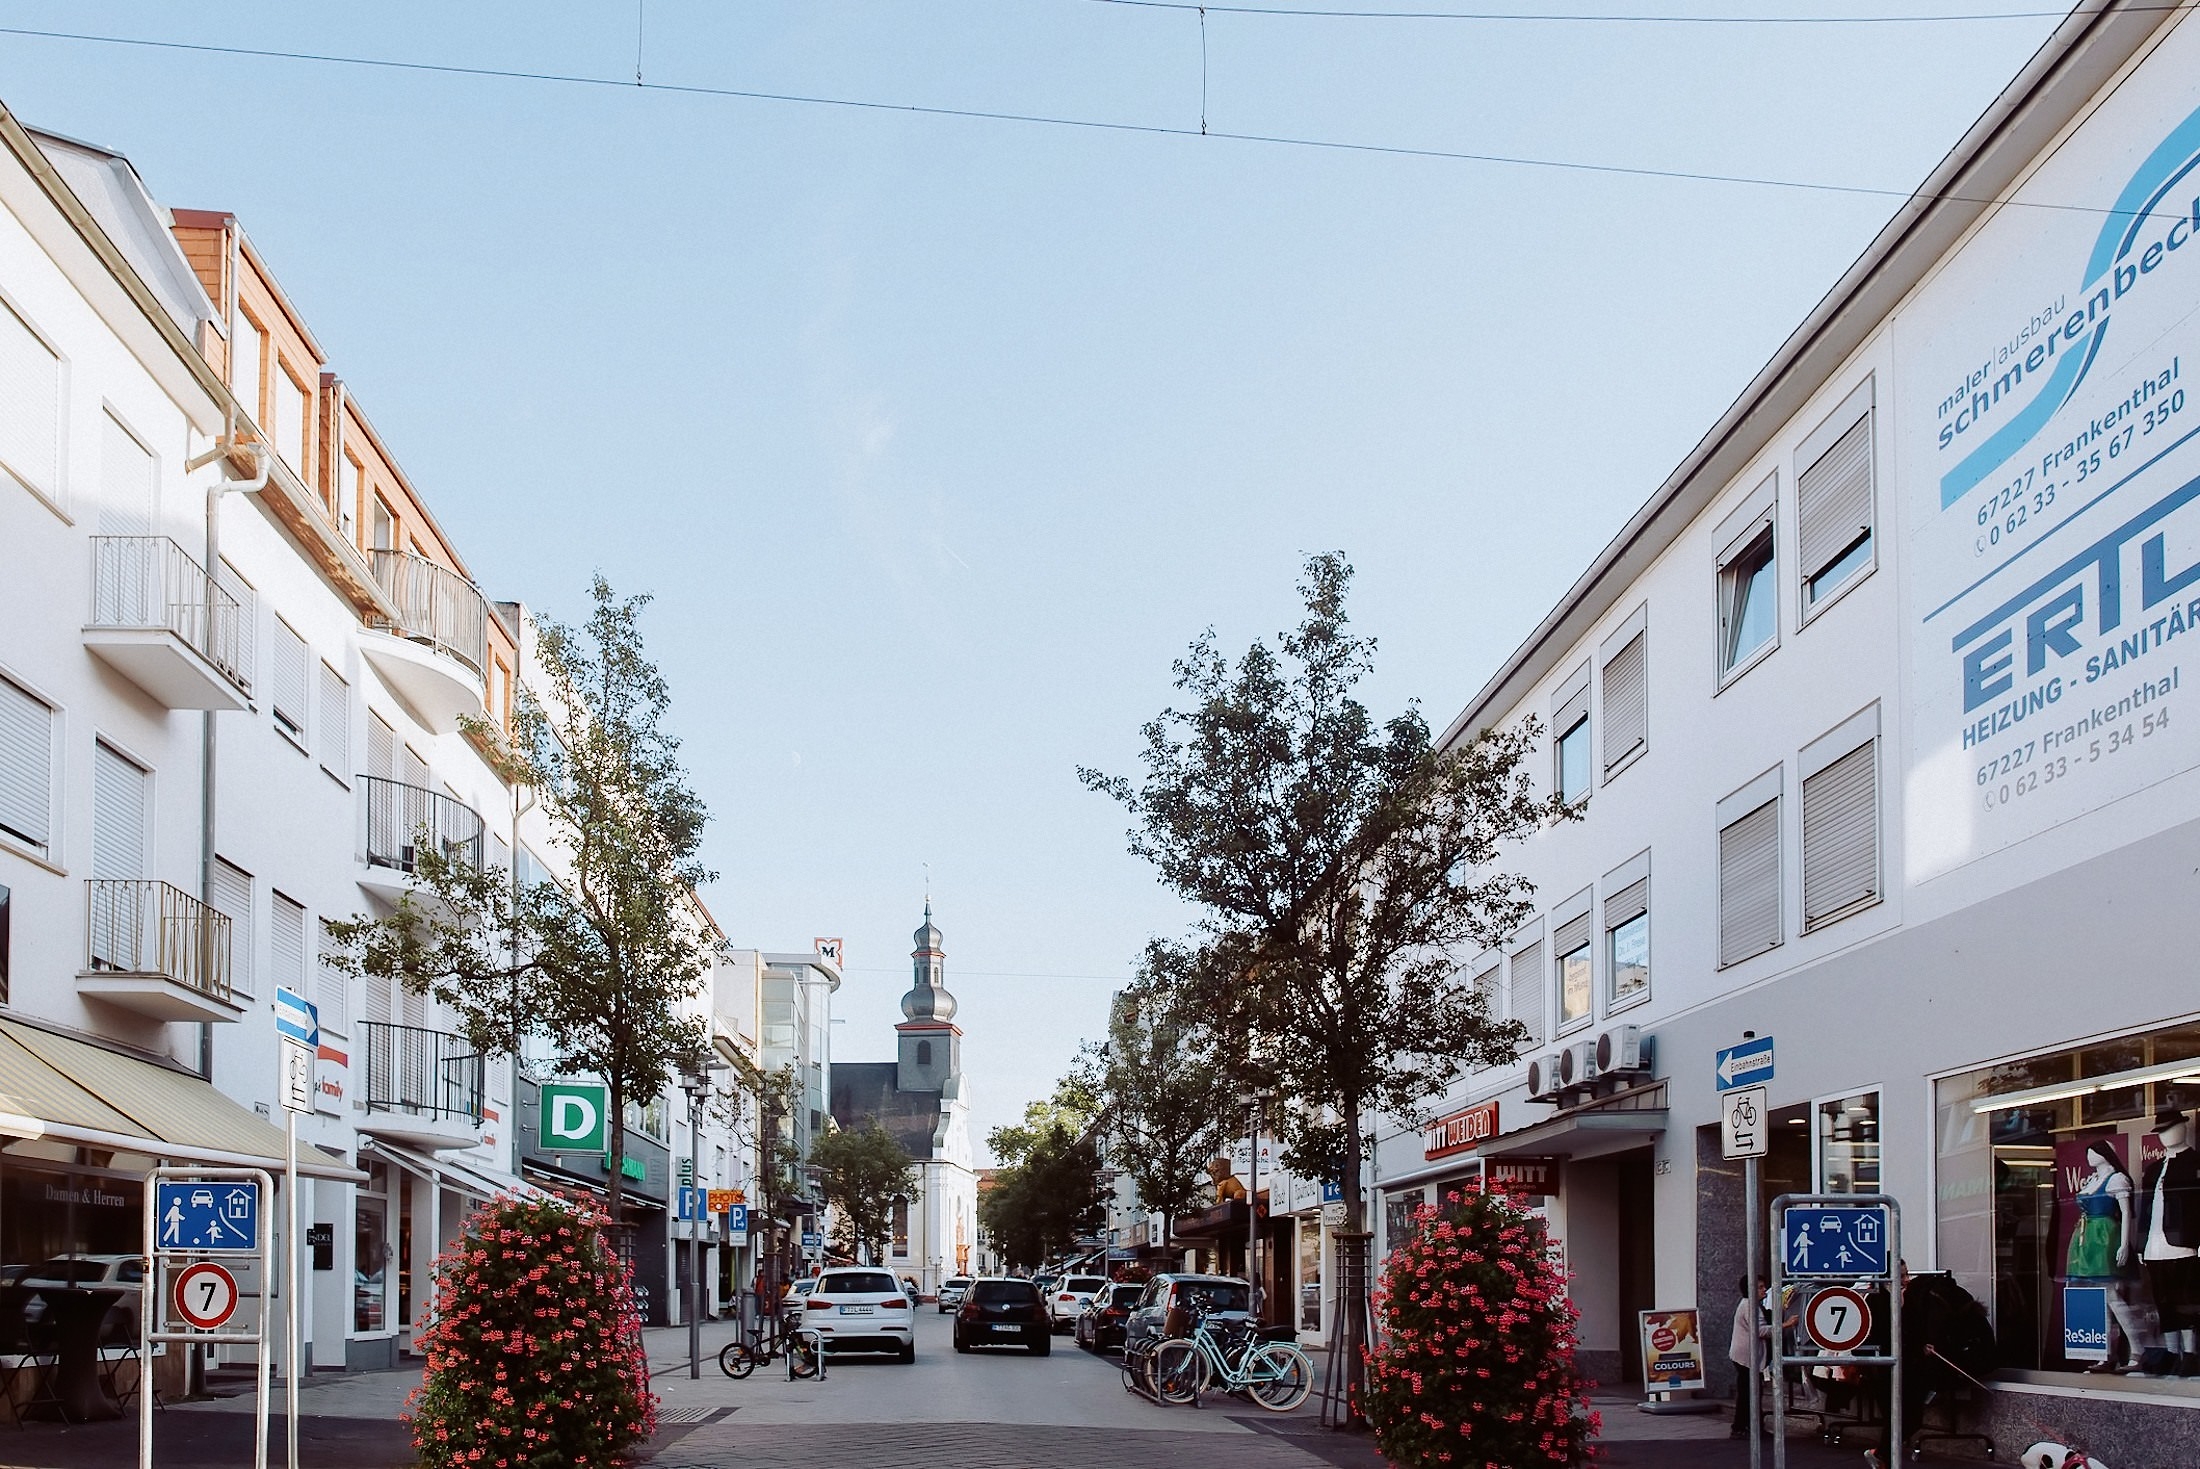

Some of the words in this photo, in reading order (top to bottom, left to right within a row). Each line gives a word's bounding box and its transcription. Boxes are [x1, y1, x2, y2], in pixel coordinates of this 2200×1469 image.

[1977, 467, 2036, 527] 67227
[2043, 356, 2179, 477] Frankenthal
[1990, 526, 2000, 546] 0
[2006, 505, 2027, 534] 62
[2033, 483, 2055, 515] 33
[2076, 449, 2101, 483] 35
[2109, 424, 2135, 460] 67
[2142, 388, 2185, 436] 350
[1952, 474, 2200, 715] ERTL
[1962, 677, 2063, 751] HEIZUNG
[1977, 741, 2036, 786] 67227
[2043, 666, 2179, 754] Frankenthal
[2000, 784, 2010, 805] 0
[2016, 770, 2038, 797] 62
[2044, 756, 2068, 785] 33
[2089, 739, 2101, 763] 5
[2108, 723, 2135, 754] 34
[2142, 706, 2170, 739] 54
[821, 946, 836, 958] M
[1731, 1053, 1771, 1073] Einbahnstraße
[552, 1095, 597, 1140] D
[1424, 1126, 1447, 1152] WITT
[1495, 1165, 1547, 1183] WITT
[45, 1183, 80, 1203] Damen
[93, 1189, 125, 1208] Herren
[732, 1207, 744, 1229] P
[200, 1282, 217, 1312] 7
[1830, 1306, 1848, 1336] 7
[2064, 1328, 2107, 1344] ReSales
[1654, 1361, 1696, 1371] COLOURS
